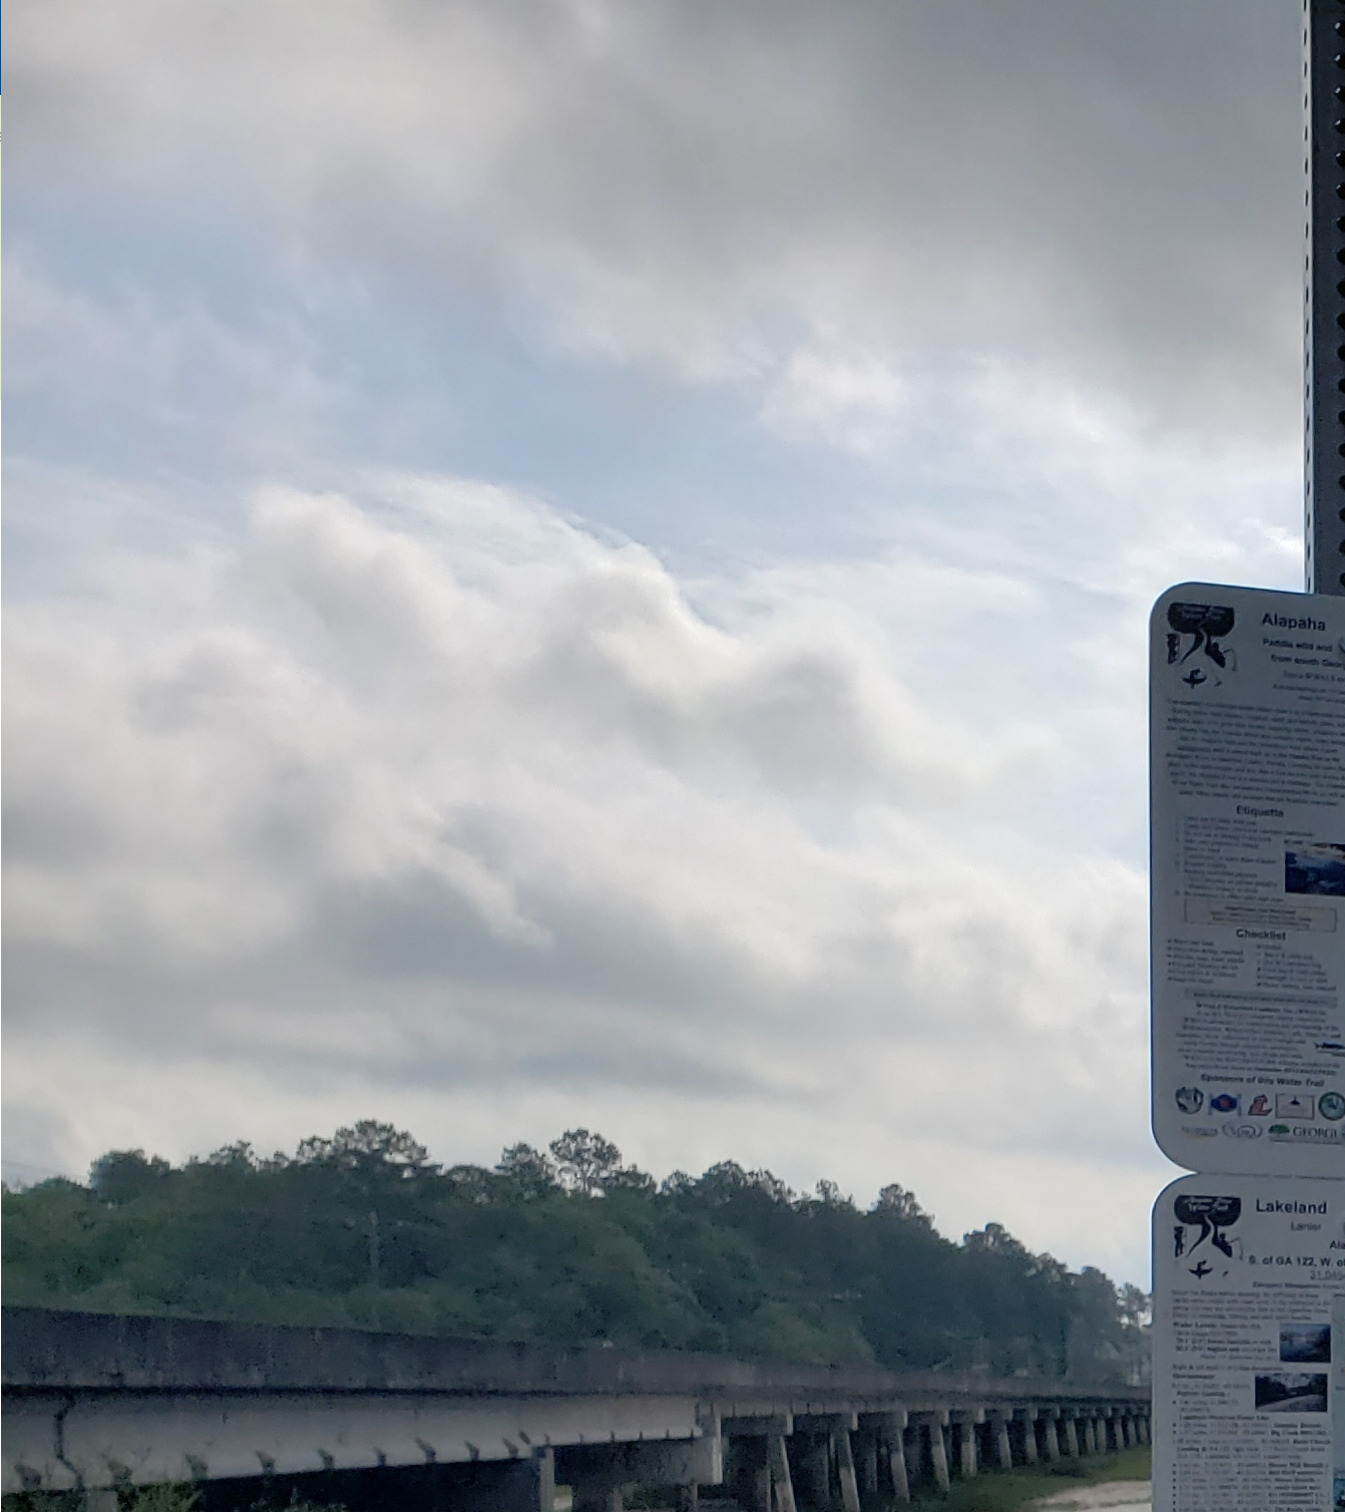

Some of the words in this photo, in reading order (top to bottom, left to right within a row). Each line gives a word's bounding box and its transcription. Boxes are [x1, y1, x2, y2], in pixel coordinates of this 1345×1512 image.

[1261, 613, 1326, 631] Alapaha
[1271, 654, 1292, 662] from
[1294, 657, 1319, 666] south
[1236, 805, 1284, 819] Etiquette
[1236, 928, 1286, 941] Checklist
[1200, 1073, 1243, 1083] Sponsors
[1277, 1077, 1302, 1086] Water
[1306, 1079, 1325, 1087] Trail
[1293, 1126, 1338, 1138] GEORGI
[1256, 1199, 1327, 1214] Lakeland
[1291, 1221, 1321, 1231] Lanier
[1262, 1255, 1273, 1266] of
[1276, 1256, 1293, 1266] GA
[1297, 1256, 1317, 1267] 122,
[1320, 1257, 1334, 1267] W.
